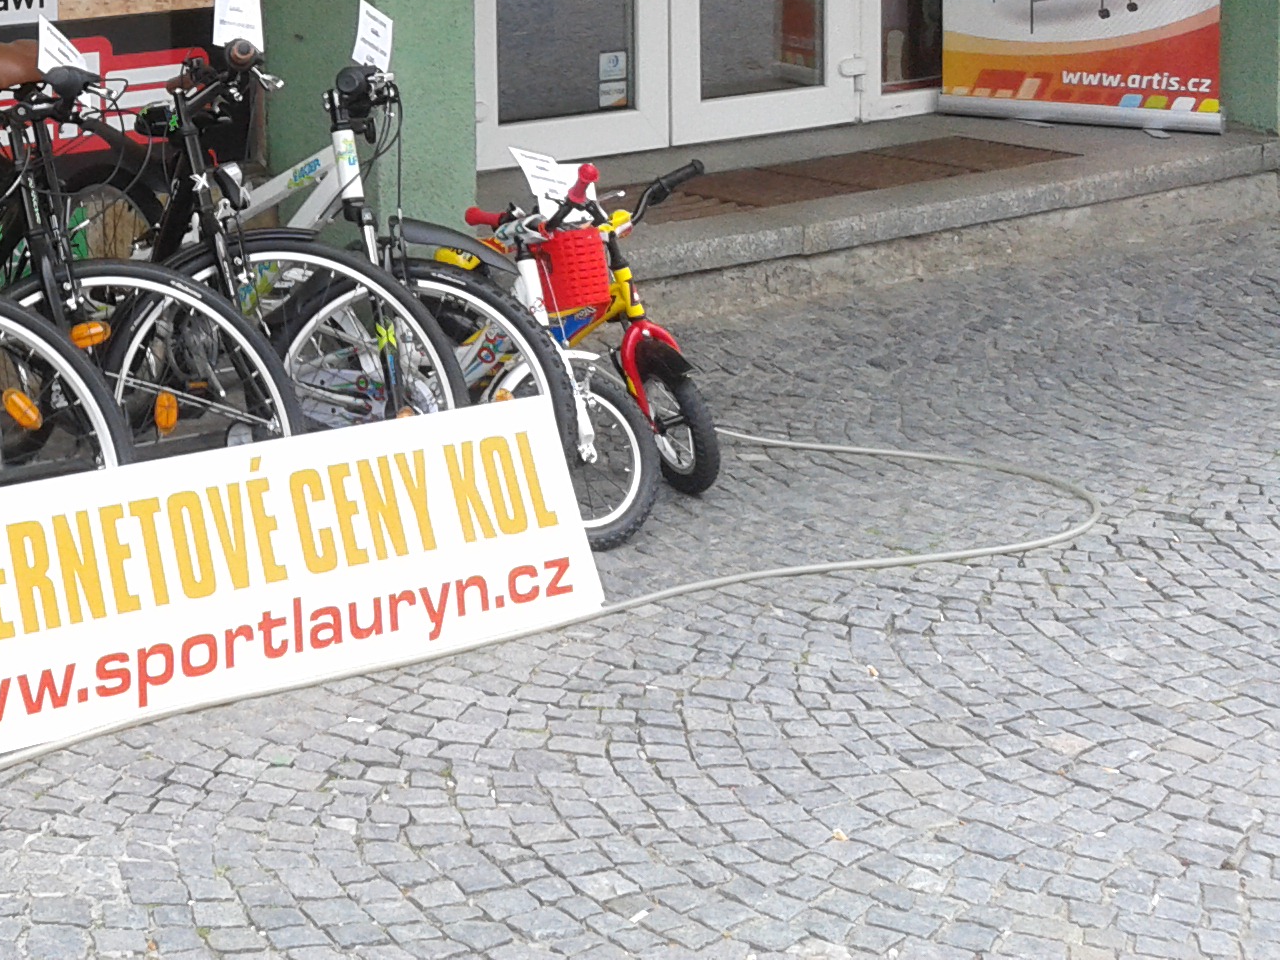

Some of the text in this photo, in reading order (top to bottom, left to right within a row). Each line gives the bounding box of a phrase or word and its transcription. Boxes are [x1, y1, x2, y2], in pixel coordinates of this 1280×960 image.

[1061, 69, 1213, 94] www.artis.cz
[288, 449, 437, 573] CENY
[442, 431, 559, 544] KOL
